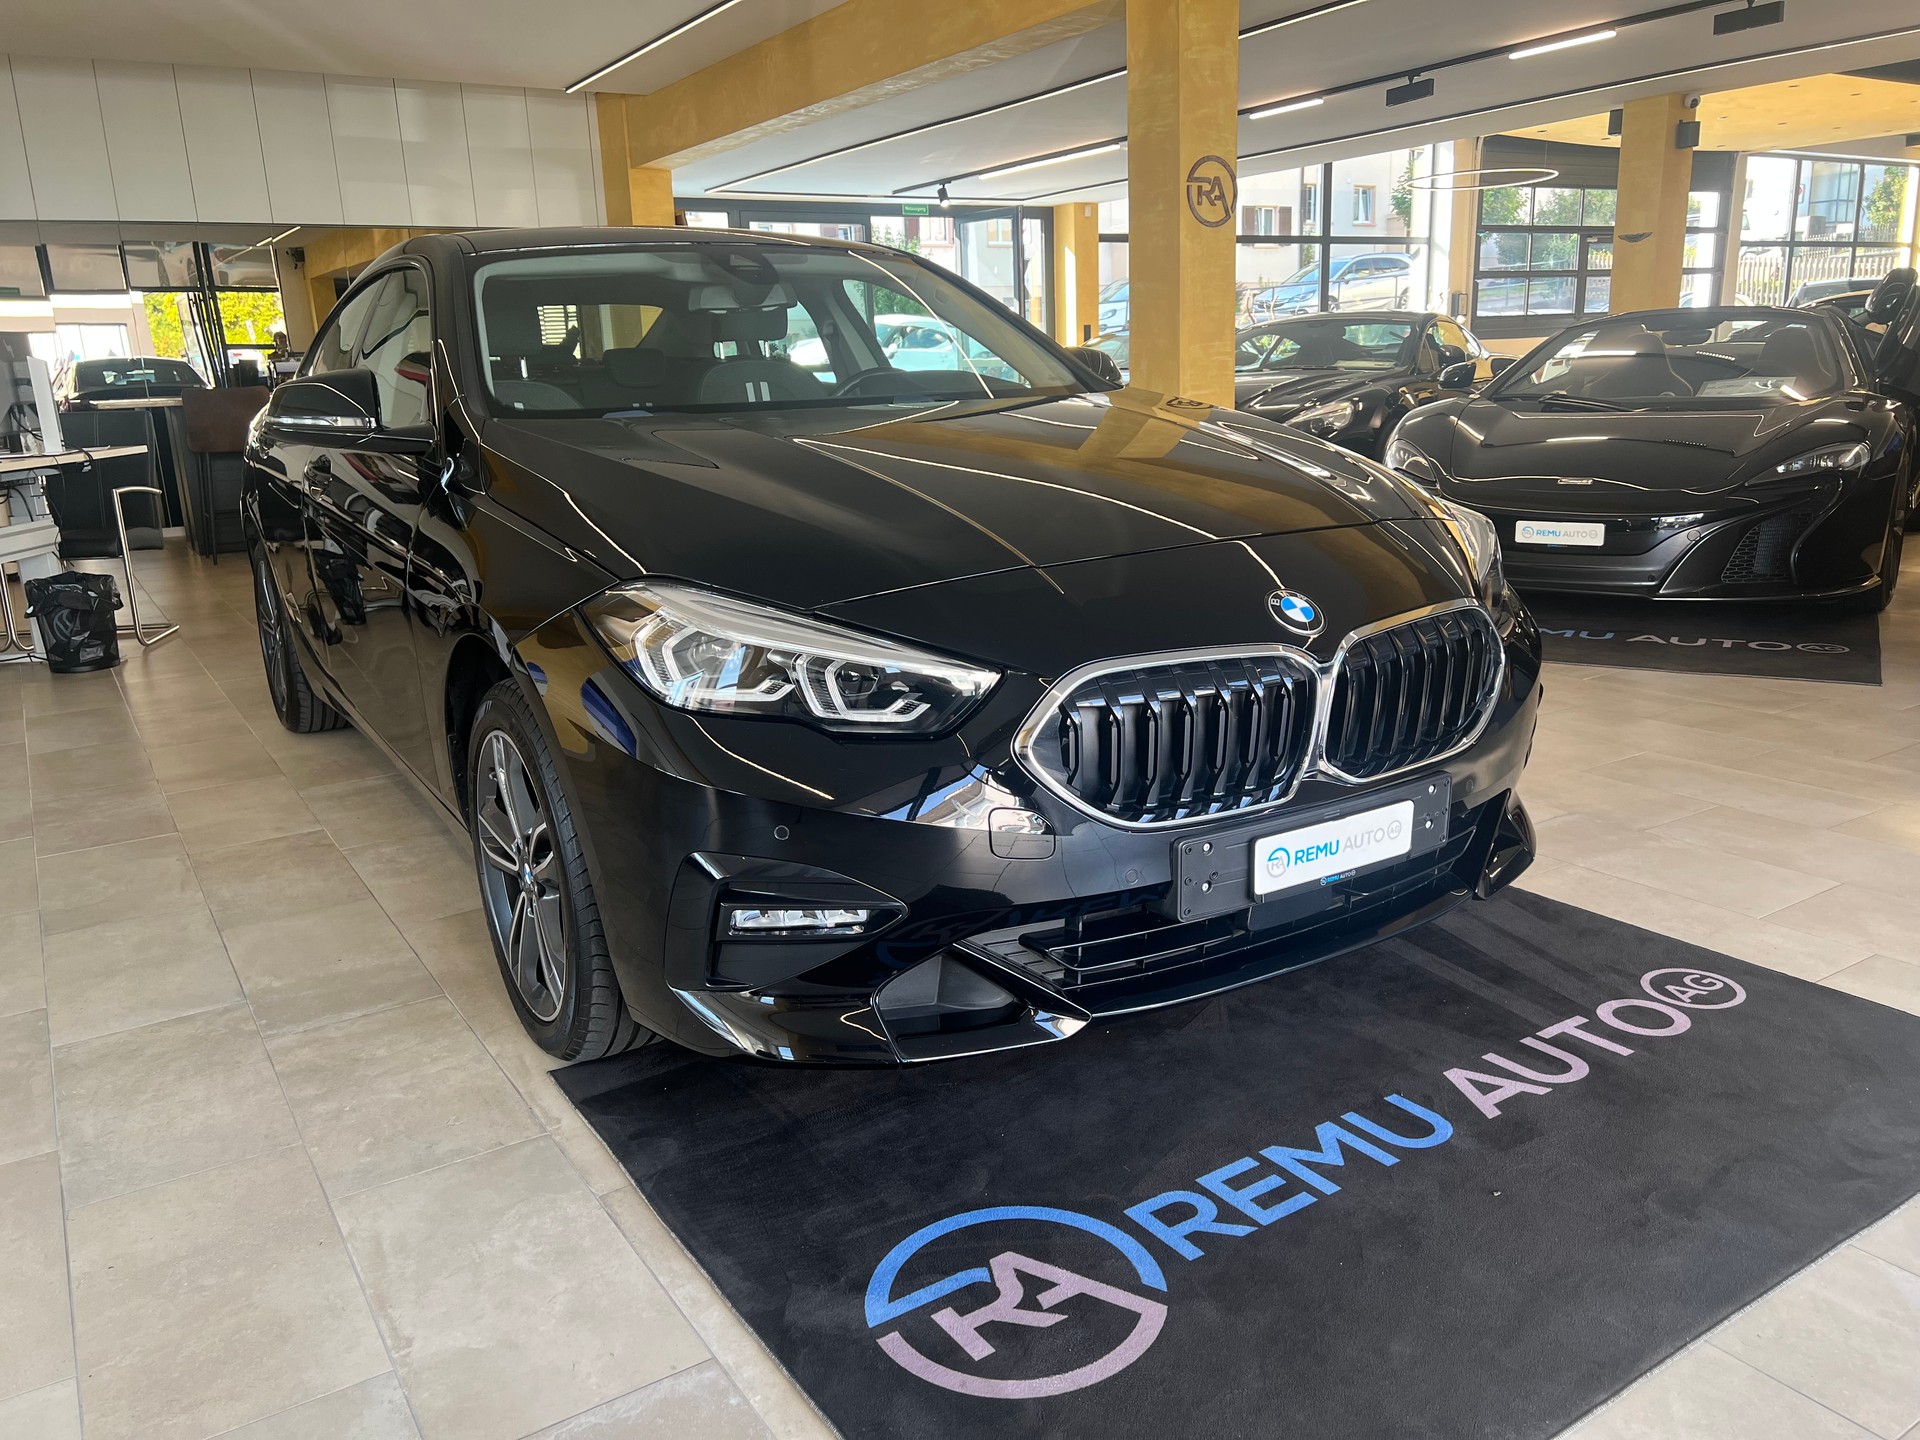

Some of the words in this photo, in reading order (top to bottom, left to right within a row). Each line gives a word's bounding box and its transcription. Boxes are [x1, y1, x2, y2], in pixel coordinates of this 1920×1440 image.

[1535, 529, 1561, 537] REMU
[1562, 530, 1588, 538] AUTO
[1538, 627, 1615, 640] MU
[1625, 634, 1793, 651] AUTO
[1294, 839, 1339, 865] REMU
[1342, 827, 1386, 852] AUTO
[1123, 1093, 1454, 1261] REMU
[1442, 998, 1692, 1119] AUTO
[1664, 974, 1723, 1003] AG
